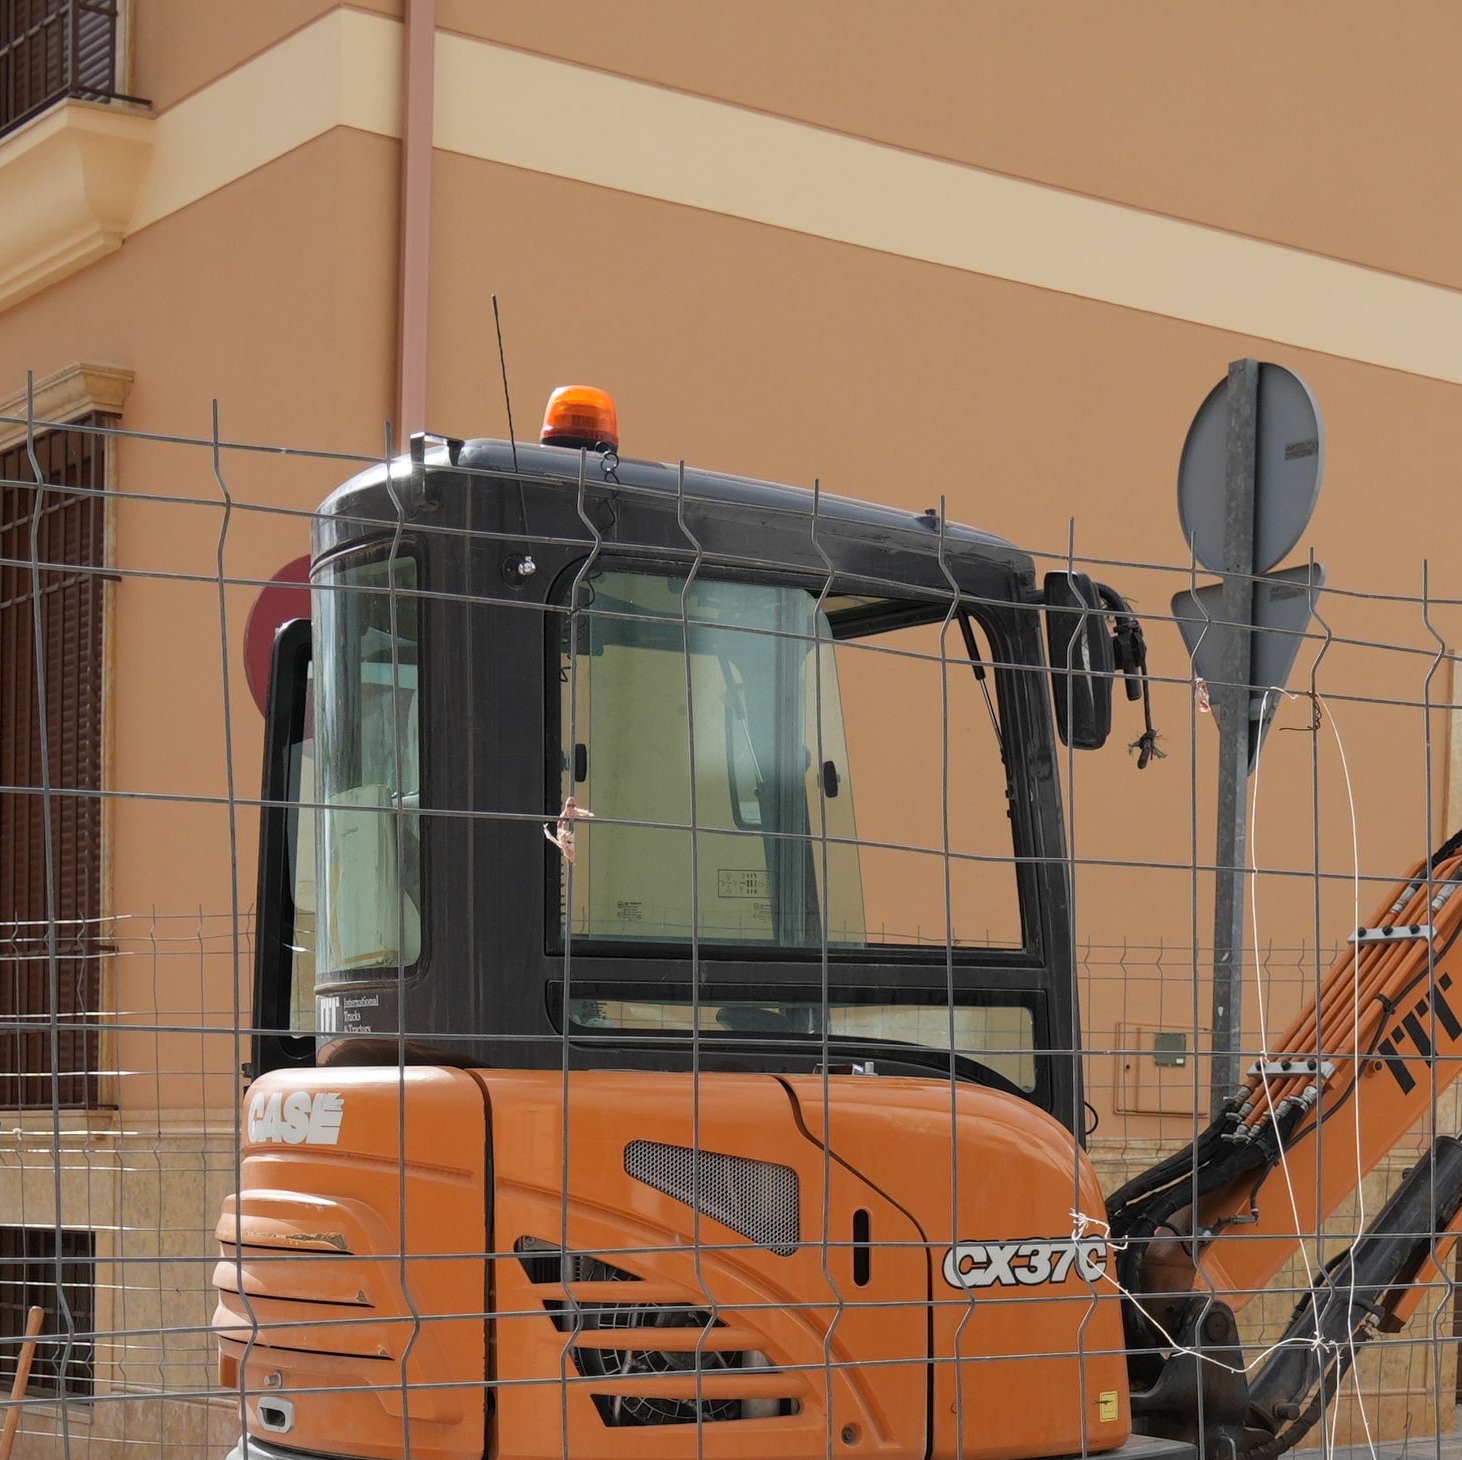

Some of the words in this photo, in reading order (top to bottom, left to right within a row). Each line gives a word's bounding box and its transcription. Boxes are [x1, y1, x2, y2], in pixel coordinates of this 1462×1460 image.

[343, 995, 379, 1008] International
[343, 1011, 362, 1023] Trucks
[247, 1091, 345, 1145] CASE
[942, 1234, 1110, 1290] CX37C
